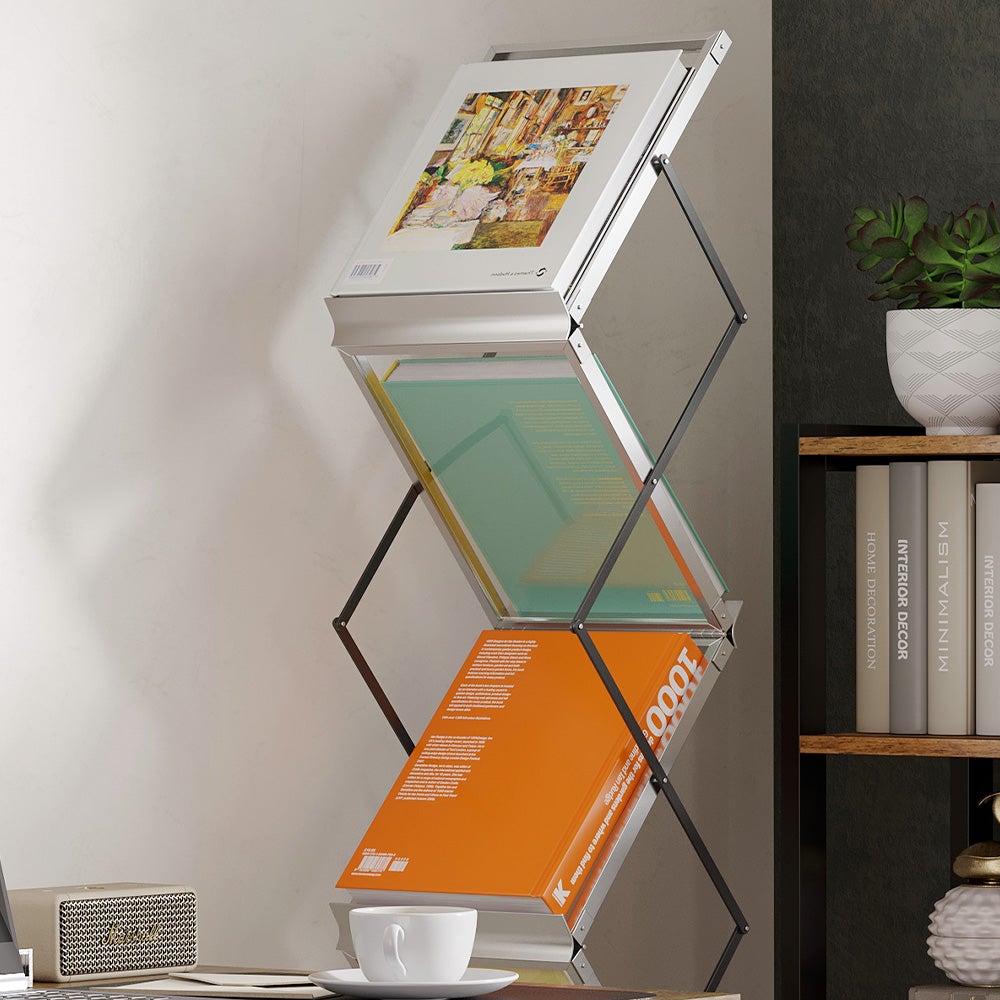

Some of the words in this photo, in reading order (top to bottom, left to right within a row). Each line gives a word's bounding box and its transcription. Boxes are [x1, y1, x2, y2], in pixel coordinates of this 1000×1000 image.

[867, 532, 876, 573] HOME
[897, 539, 909, 608] INTERIOR
[938, 521, 949, 672] MINIMALISM
[984, 555, 994, 618] INTERIOR
[867, 578, 876, 670] DECORATION
[897, 611, 909, 660] DECOR
[984, 622, 994, 667] DECOR
[645, 646, 698, 738] 1000
[622, 759, 630, 774] and
[626, 772, 635, 784] the
[633, 761, 641, 773] for
[602, 783, 619, 805] Rudge
[610, 782, 628, 811] gardens
[604, 809, 613, 825] and
[592, 823, 608, 845] where
[580, 852, 591, 868] find
[588, 844, 595, 853] to
[570, 866, 583, 885] them
